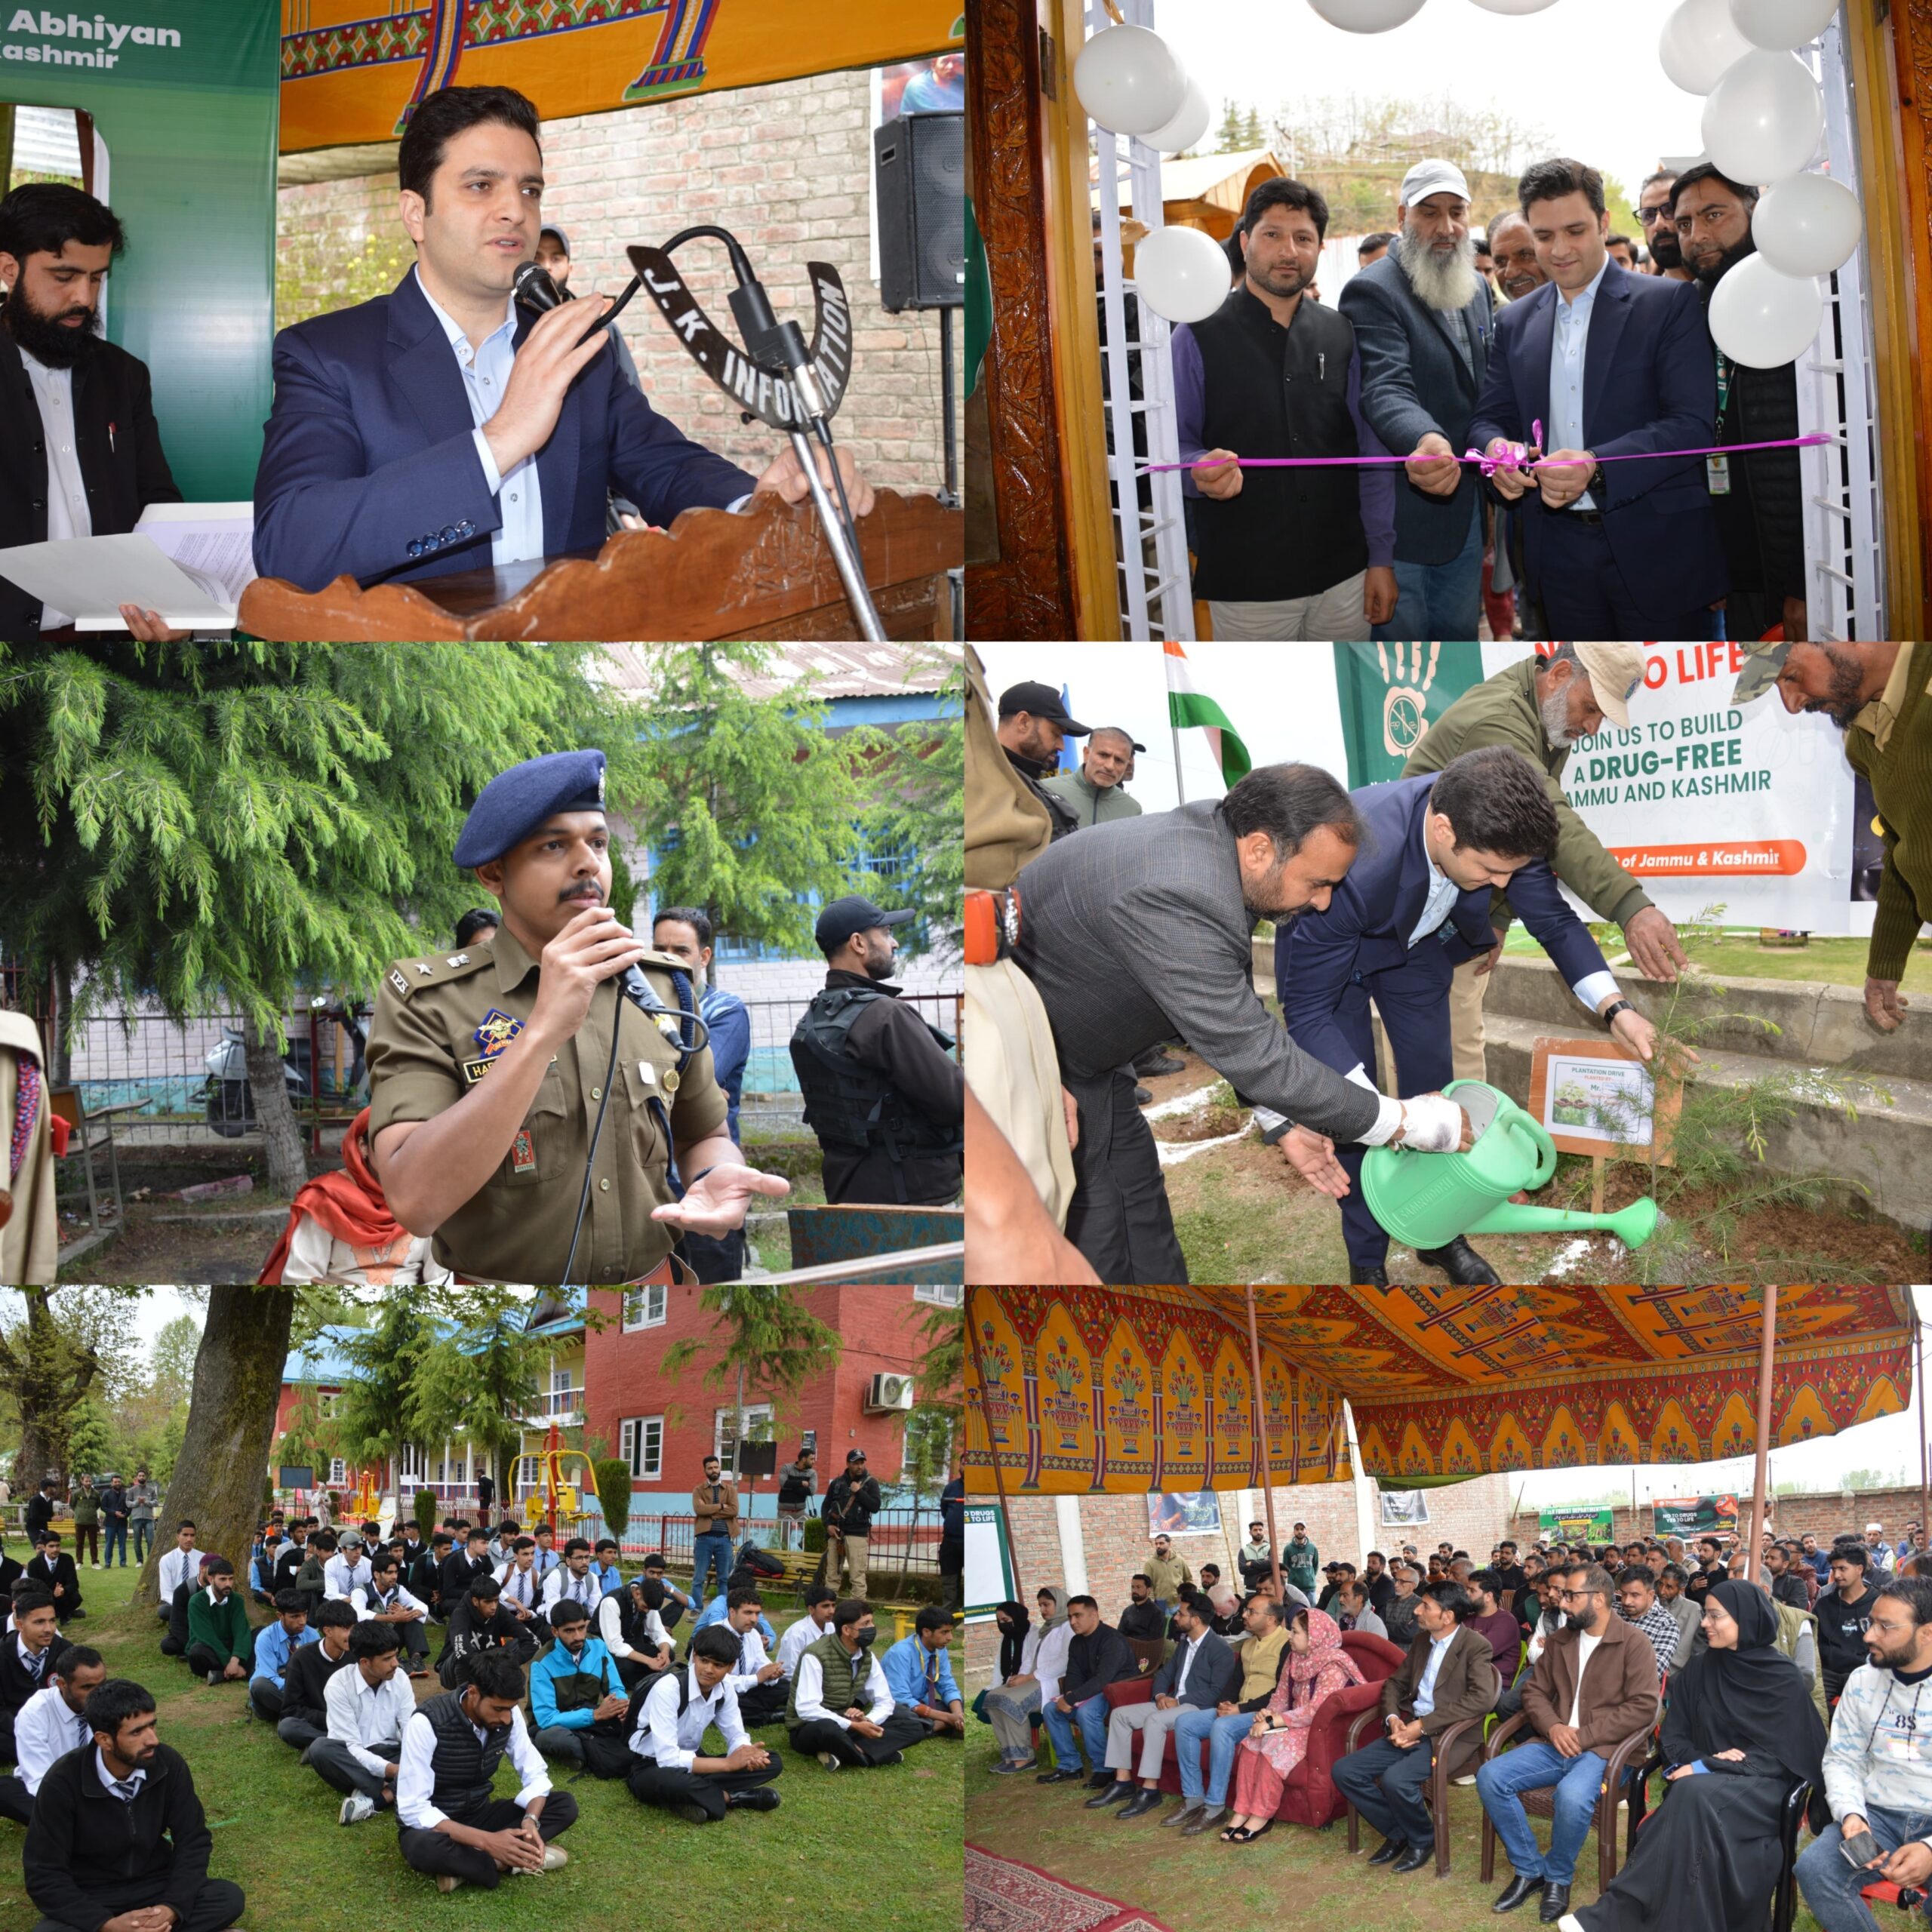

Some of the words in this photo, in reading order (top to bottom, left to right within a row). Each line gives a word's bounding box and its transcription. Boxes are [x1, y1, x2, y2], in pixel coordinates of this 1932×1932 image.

[7, 9, 181, 50] Abhiyan
[0, 40, 119, 69] ashmir
[1676, 641, 1745, 685] LIFE
[1571, 730, 1613, 755] JOIN
[1617, 725, 1642, 747] US
[1647, 721, 1675, 742] TO
[1681, 709, 1743, 737] BUILD
[1574, 766, 1586, 784] A
[1589, 738, 1742, 783] DRUG-FREE
[1624, 781, 1666, 803] AND
[1672, 770, 1772, 798] KASHMIR
[1621, 854, 1637, 868] of
[1638, 853, 1693, 868] Jammu
[1697, 851, 1709, 866] &
[1712, 848, 1780, 866] Kashmir
[1572, 1067, 1607, 1075] PLANTATION
